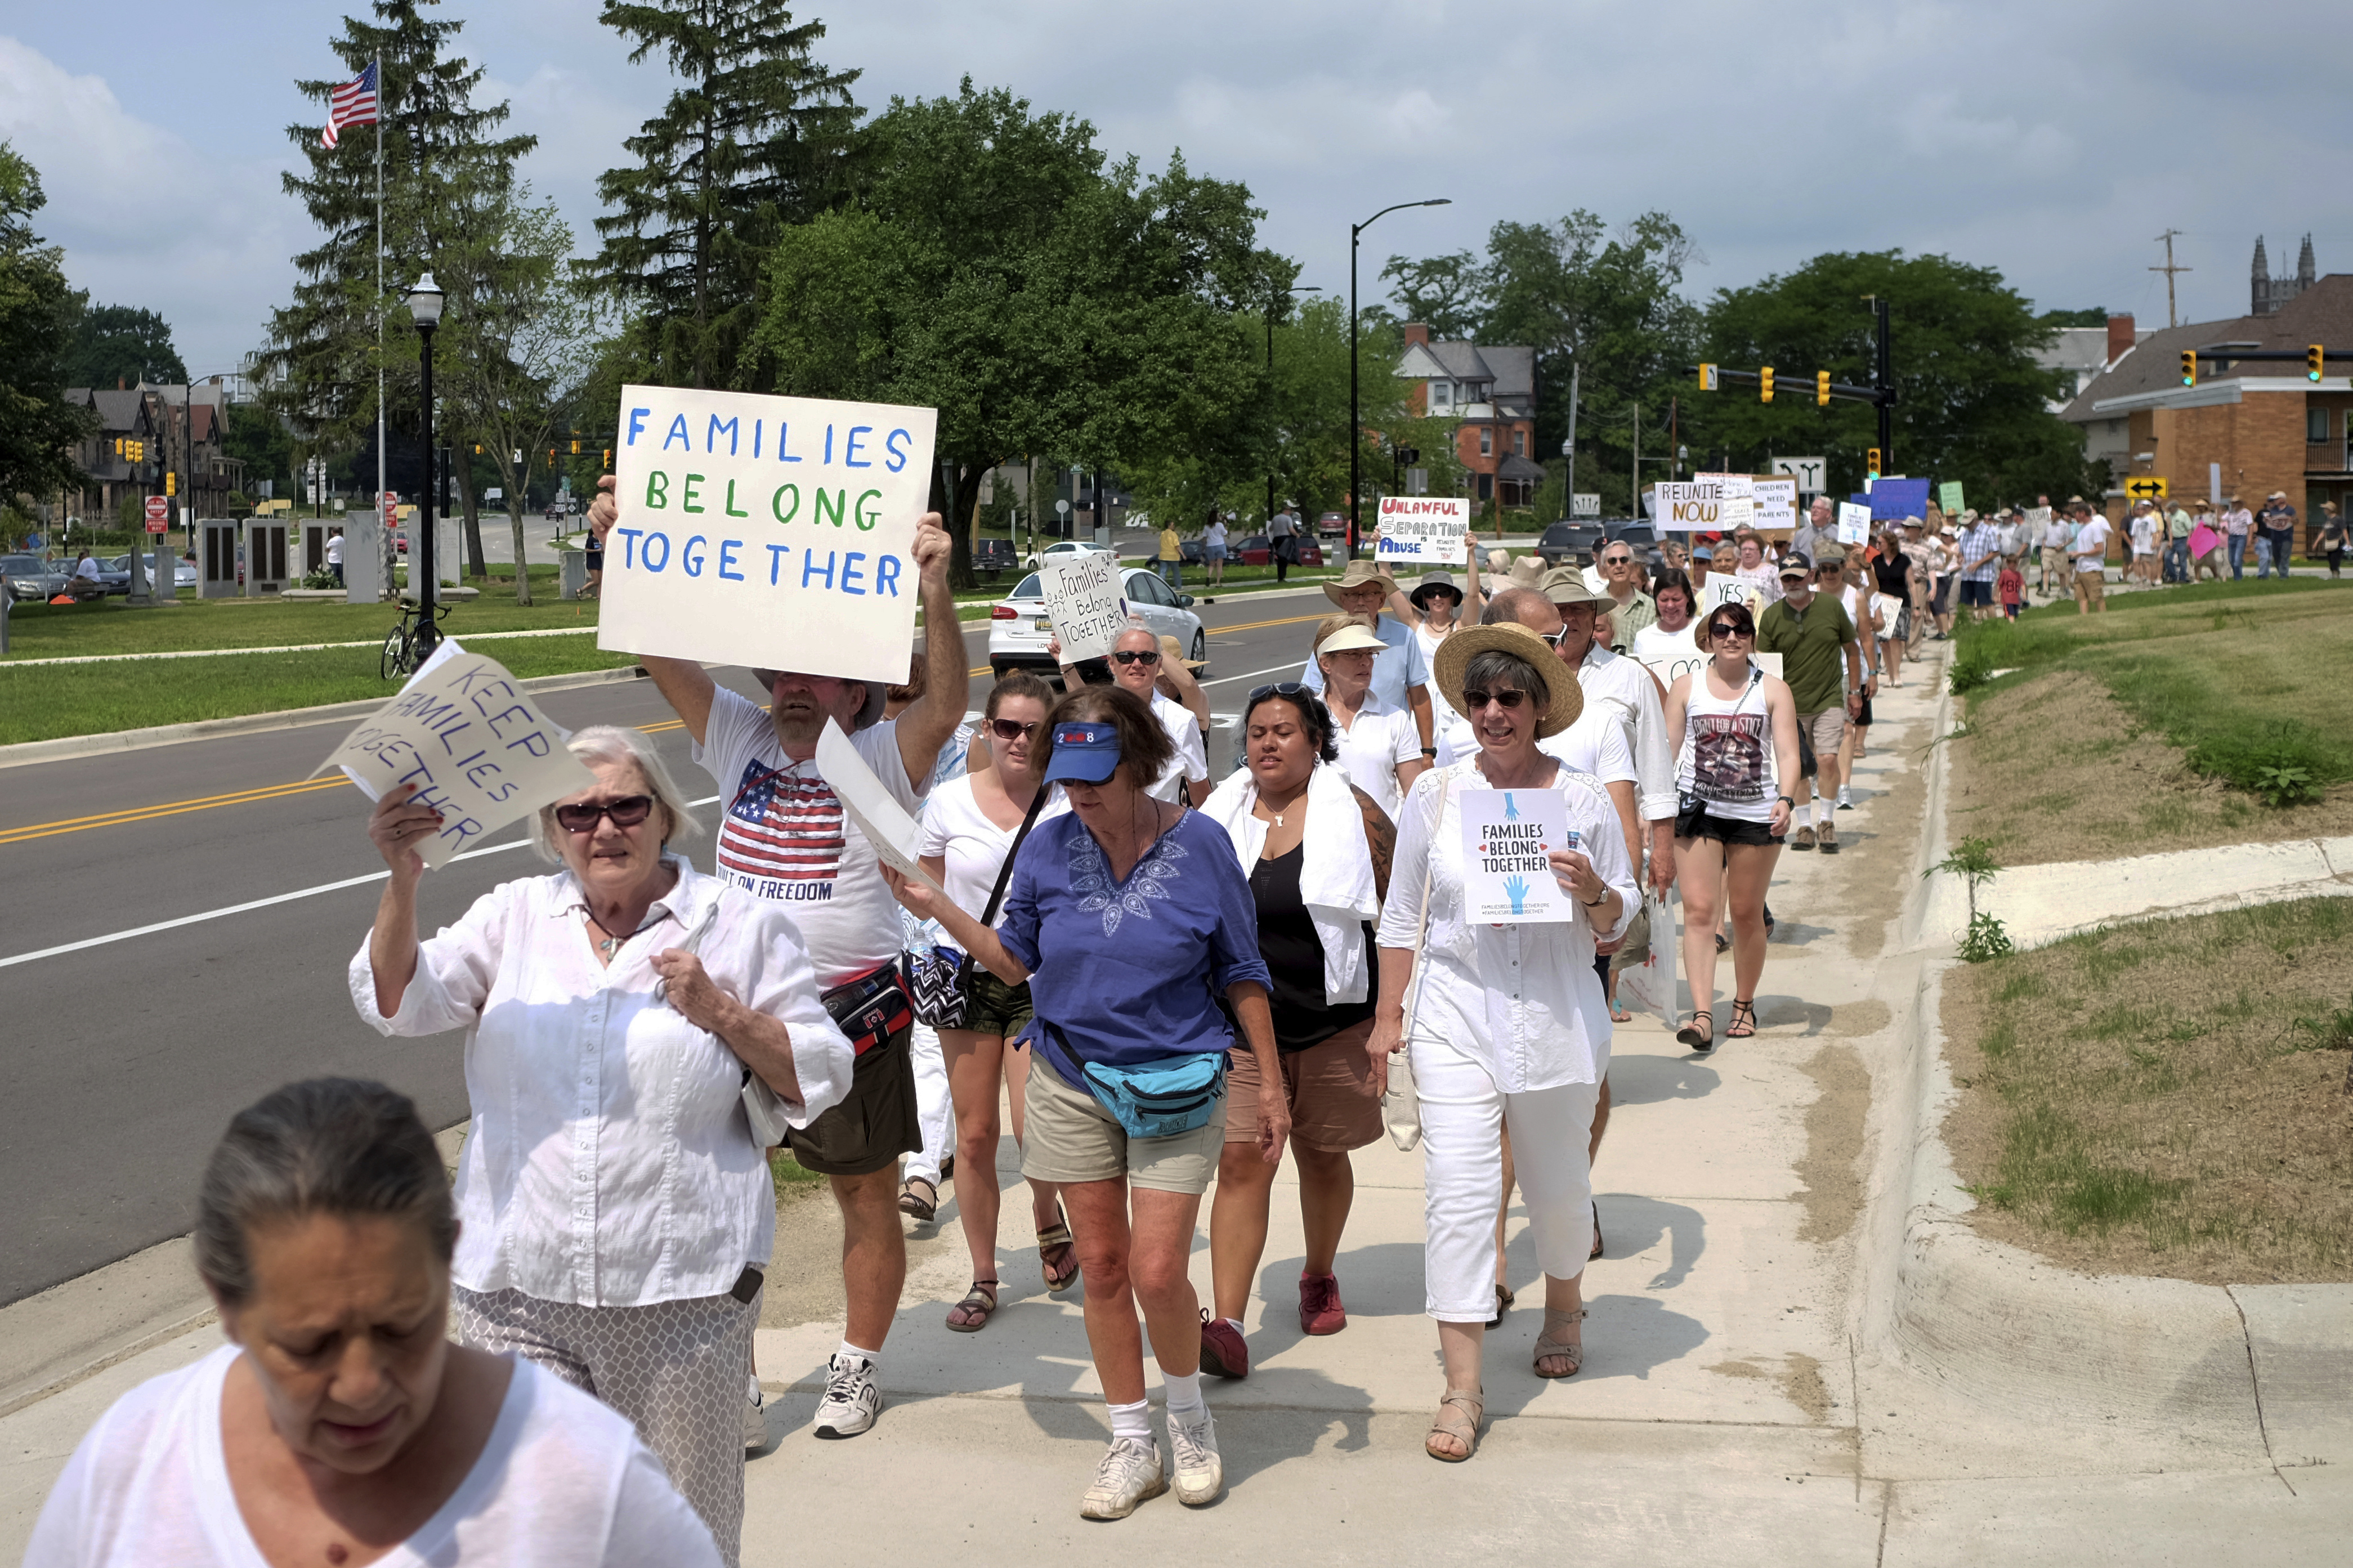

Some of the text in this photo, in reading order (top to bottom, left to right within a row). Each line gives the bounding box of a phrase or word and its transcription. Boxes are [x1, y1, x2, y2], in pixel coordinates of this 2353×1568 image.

[628, 408, 912, 472] FAMILIES
[646, 471, 882, 531] BELONG
[1662, 483, 1723, 500] REUNITE
[1382, 499, 1459, 516] UNLAWFUL
[1672, 501, 1719, 522] NOW
[1380, 516, 1466, 536] SEPARATION
[1379, 537, 1421, 553] ABUSE
[618, 528, 901, 597] TOGETHER
[1059, 561, 1108, 598] Families
[1718, 583, 1743, 604] YES
[1075, 592, 1114, 619] Belong
[1059, 610, 1125, 646] TOGETHER
[446, 664, 550, 757] KEEP
[1716, 718, 1730, 733] FOR
[1731, 718, 1762, 738] USTICE
[380, 693, 519, 802] FAMILIES
[346, 728, 483, 851] TOGETHER
[1482, 823, 1544, 839] FAMILIES
[1489, 840, 1538, 856] BELONG
[1482, 857, 1547, 873] TOGETHER
[737, 876, 755, 892] ON
[758, 880, 833, 901] FREEDOM
